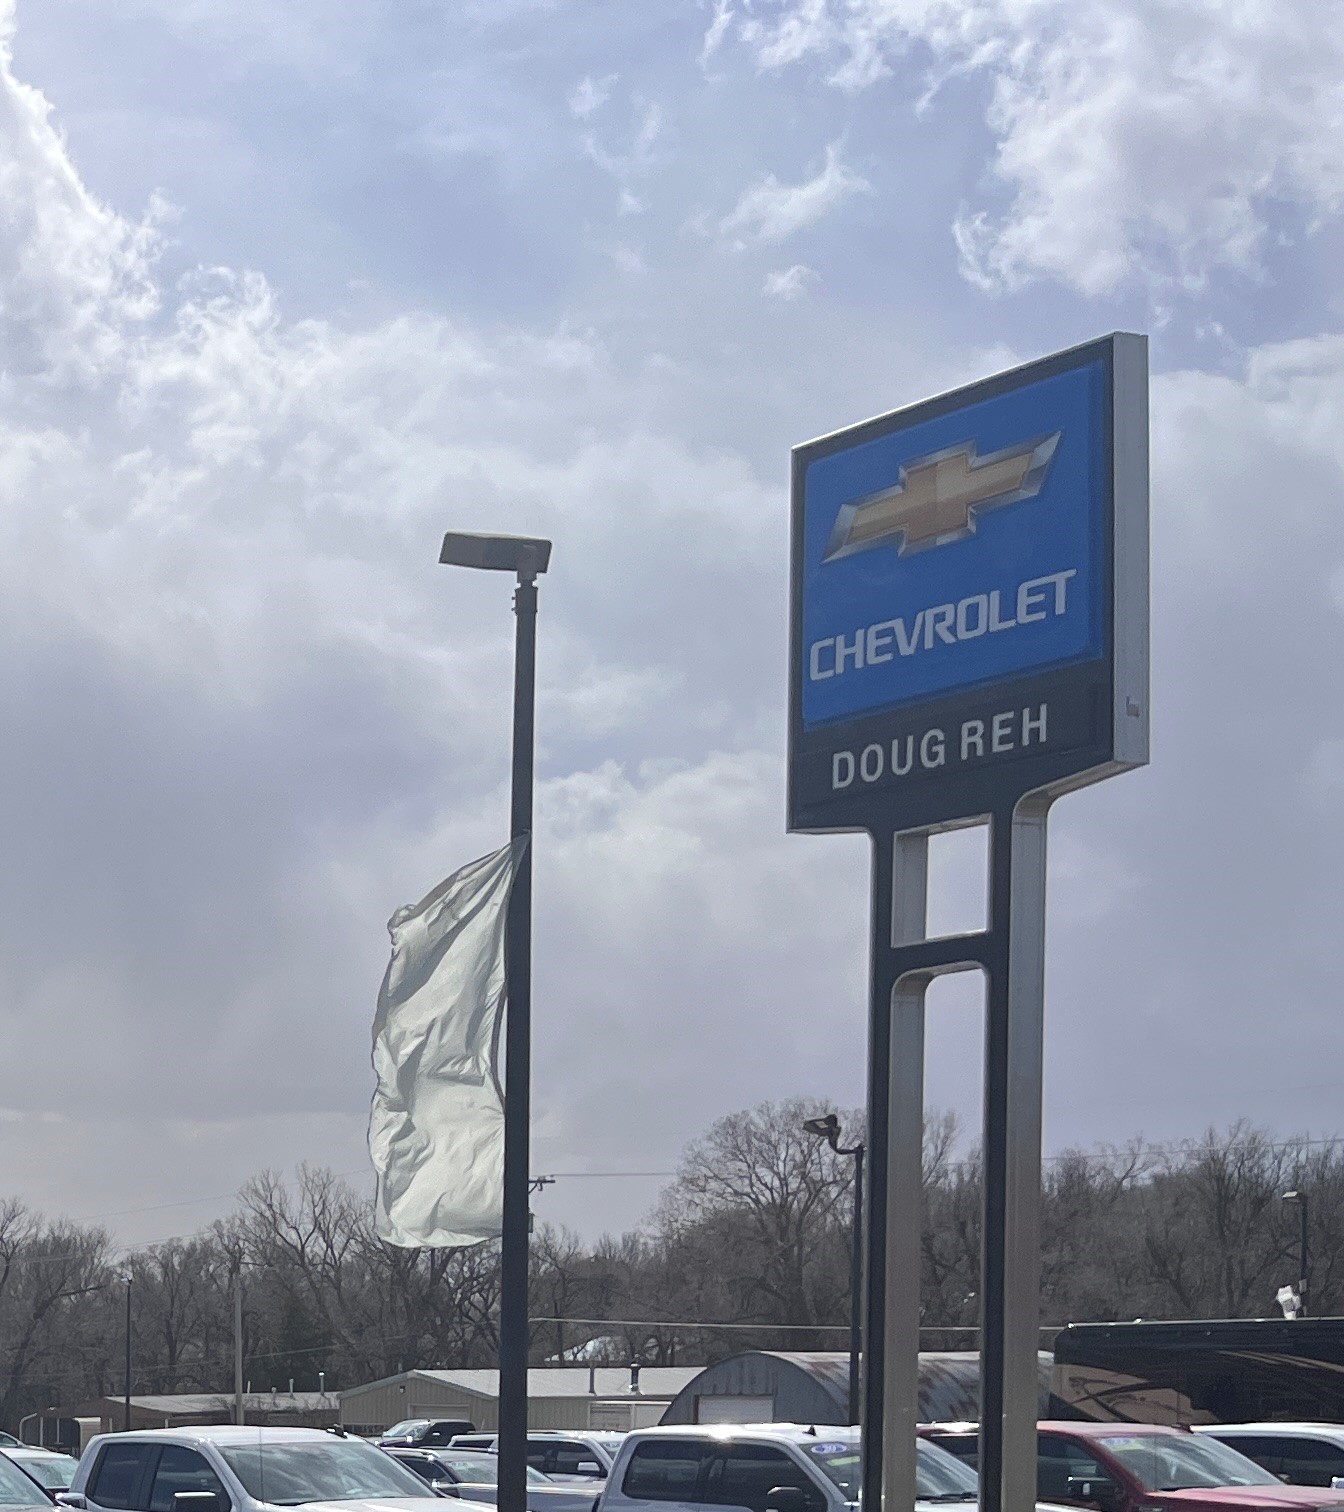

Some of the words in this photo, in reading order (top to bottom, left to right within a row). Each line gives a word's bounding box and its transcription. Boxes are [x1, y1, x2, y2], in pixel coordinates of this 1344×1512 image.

[809, 568, 1077, 681] CHEVROLET
[832, 728, 945, 789] DOUG
[961, 703, 1048, 760] REH
